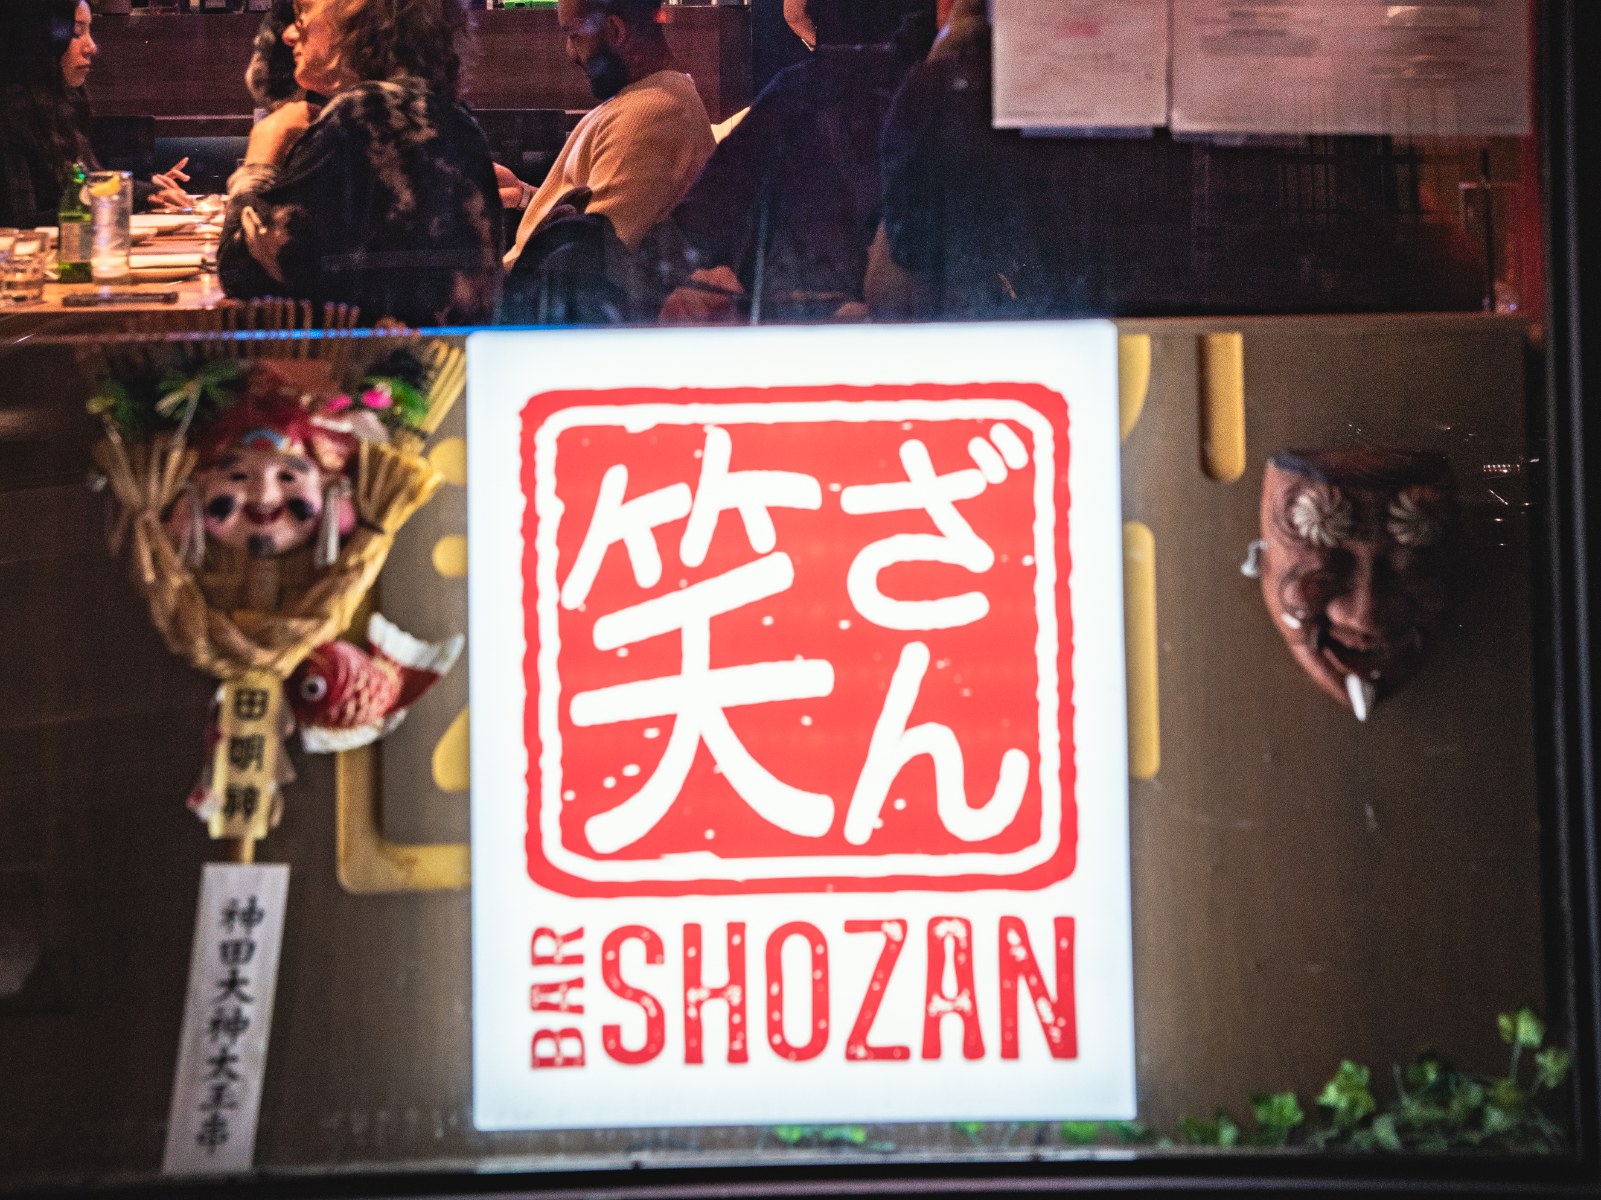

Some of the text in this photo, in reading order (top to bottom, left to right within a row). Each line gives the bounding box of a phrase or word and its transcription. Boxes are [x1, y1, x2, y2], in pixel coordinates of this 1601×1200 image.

[560, 421, 1030, 854] 笑 ざん
[530, 925, 586, 1070] BAR
[600, 915, 1079, 1067] SHOZAN
